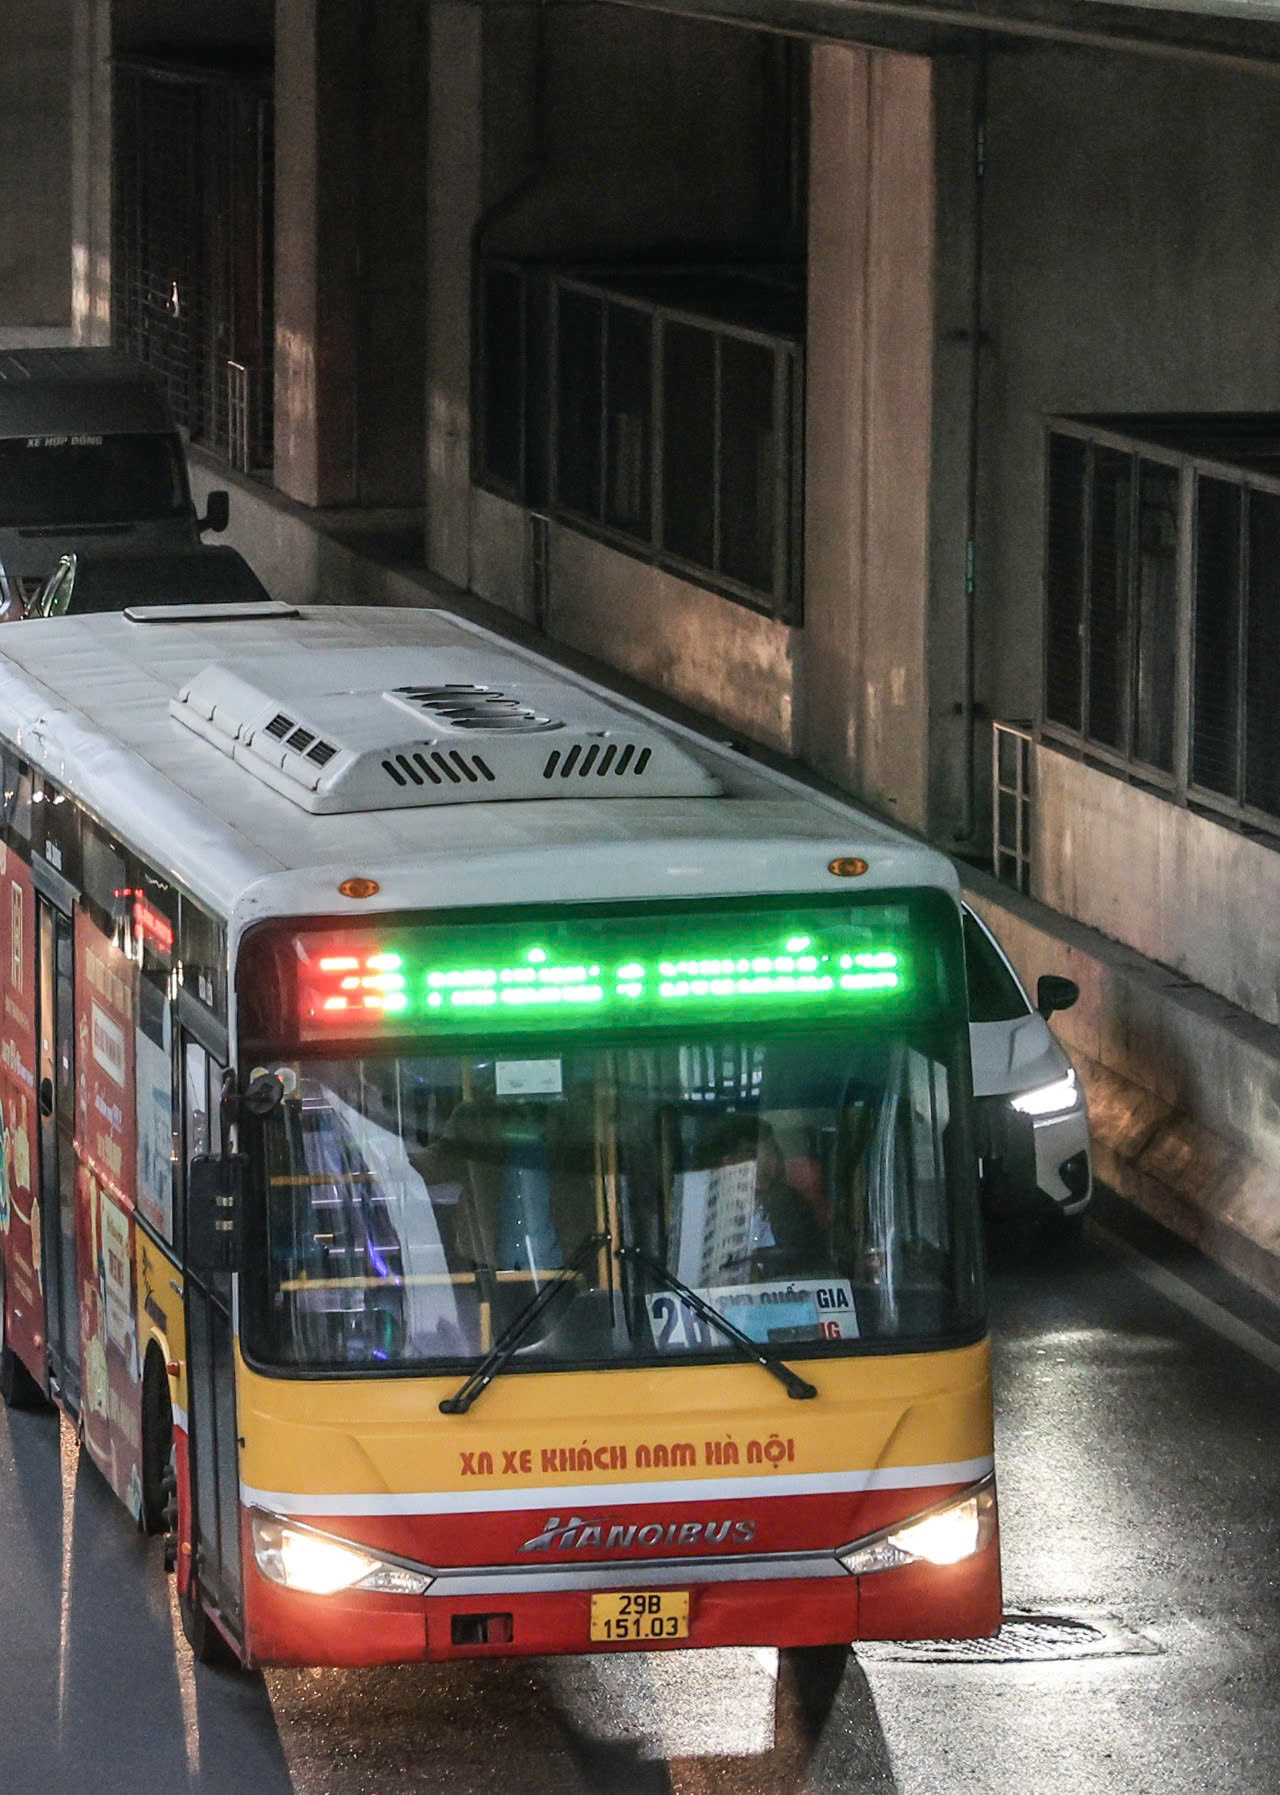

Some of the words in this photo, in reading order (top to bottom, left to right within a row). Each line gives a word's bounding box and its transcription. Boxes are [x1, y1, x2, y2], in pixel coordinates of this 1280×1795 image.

[816, 1288, 849, 1309] GIA
[501, 1449, 533, 1475] XE
[541, 1440, 628, 1473] KHÁCH
[635, 1442, 697, 1469] NAM
[705, 1433, 740, 1465] HÀ
[746, 1434, 796, 1470] NỘI
[517, 1516, 757, 1552] HANOIBUS
[618, 1594, 661, 1615] 29B
[603, 1616, 679, 1639] 151.03
